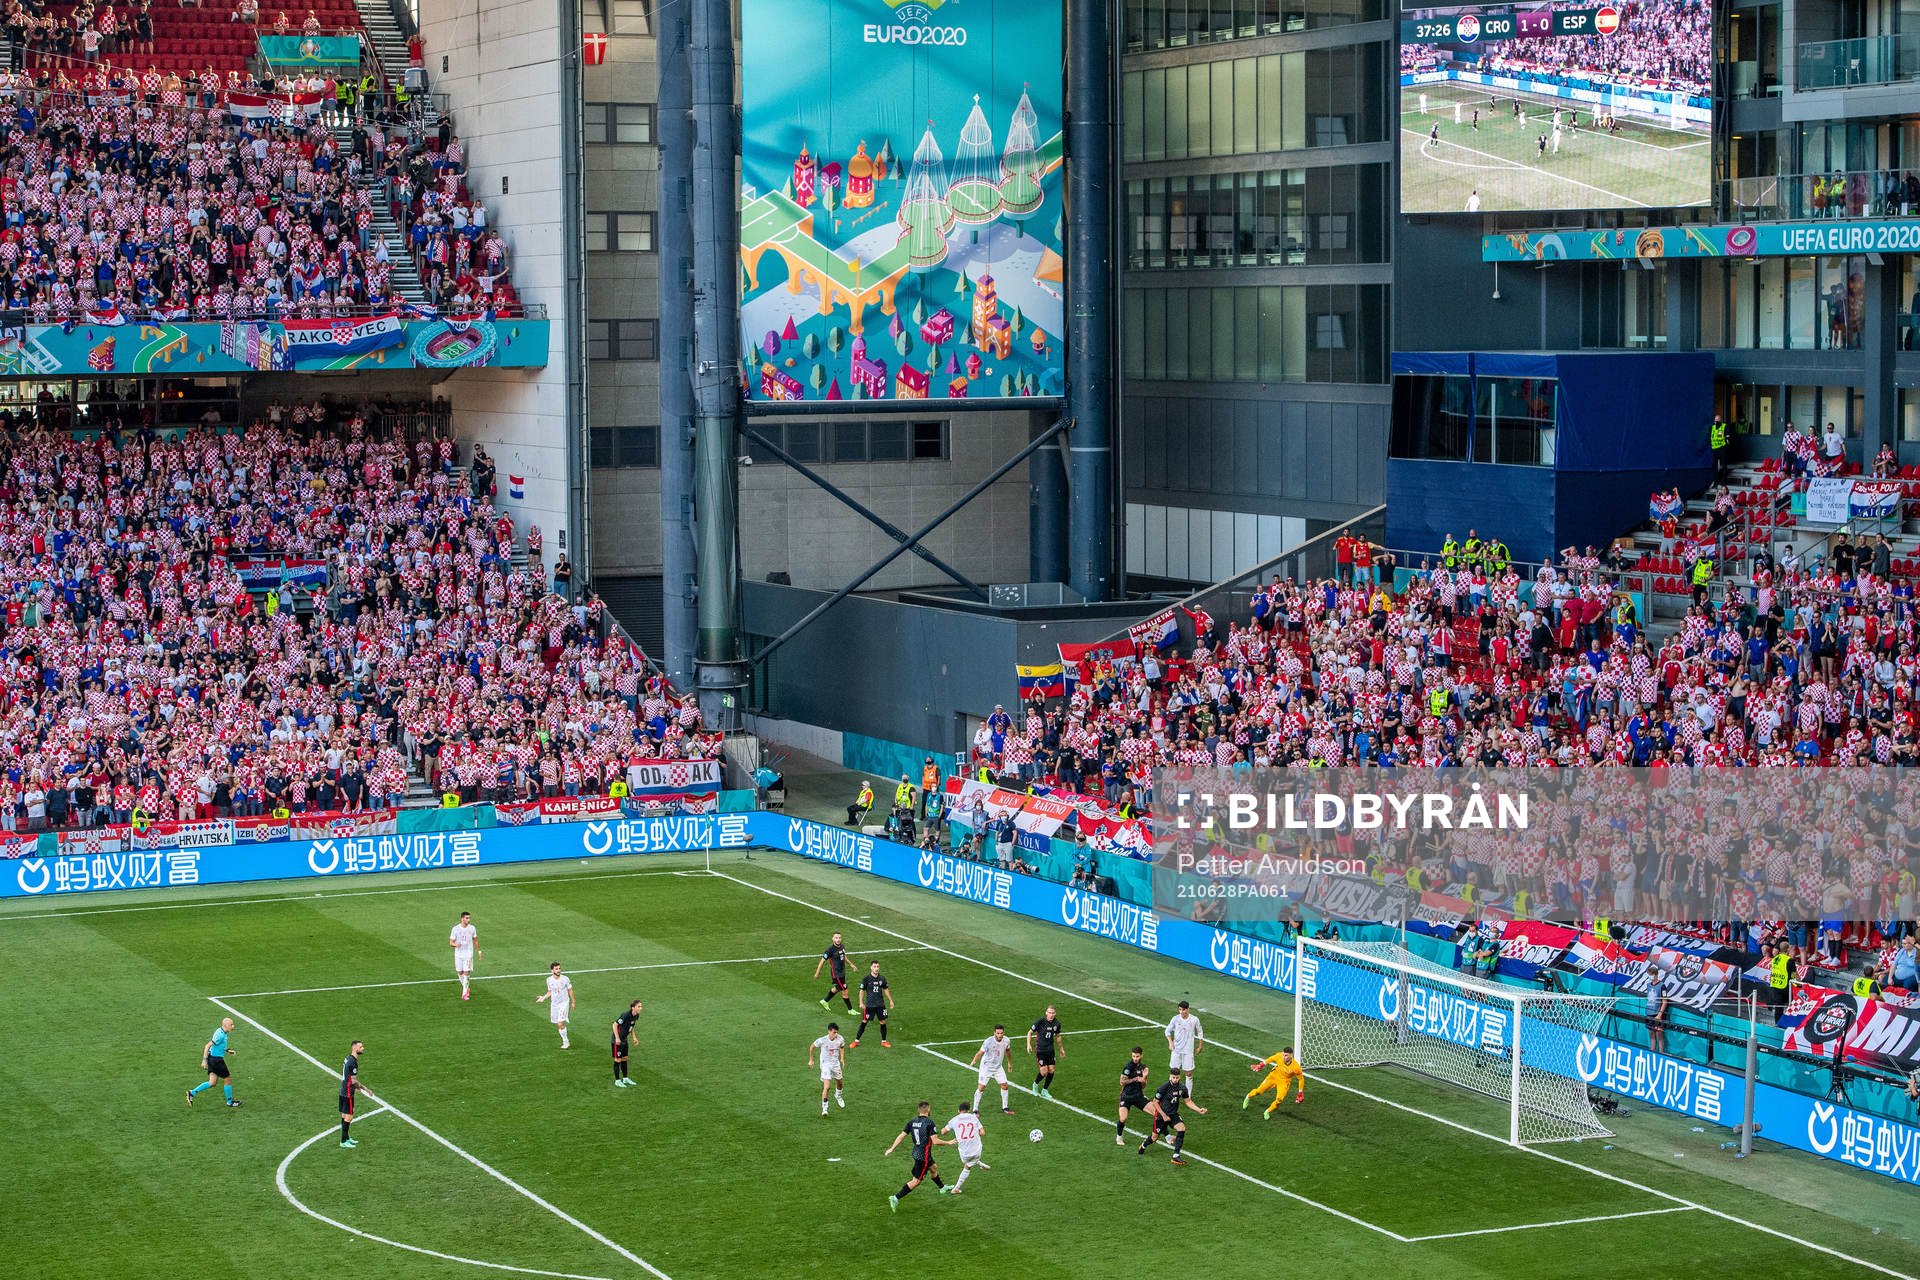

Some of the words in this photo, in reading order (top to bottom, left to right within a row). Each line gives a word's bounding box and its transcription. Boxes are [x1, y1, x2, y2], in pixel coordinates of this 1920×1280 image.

[897, 7, 929, 22] UEFA
[1416, 24, 1451, 38] 37:26
[1485, 20, 1510, 34] CRO
[1521, 20, 1528, 32] 1
[1540, 18, 1549, 31] 0
[1562, 16, 1587, 29] ESP
[1783, 229, 1826, 251] UEFA
[1828, 227, 1875, 250] EURO
[1877, 226, 1920, 249] 2020
[355, 321, 386, 337] VEC
[692, 763, 713, 782] AK
[544, 799, 616, 813] KAMEŠNICA
[1033, 800, 1067, 814] RAKITNO
[179, 832, 230, 847] HRVATSKA
[237, 829, 254, 839] IZBI
[617, 814, 748, 854] 蚂蚁财富
[343, 831, 481, 873] 蚂蚁财富
[805, 825, 874, 872] 蚂蚁财富
[55, 850, 200, 891] 蚂蚁财富
[936, 858, 1013, 909] 蚂蚁财富
[1080, 893, 1160, 951] 蚂蚁财富
[1604, 1042, 1725, 1122] 蚂蚁财富
[958, 1122, 975, 1140] 22
